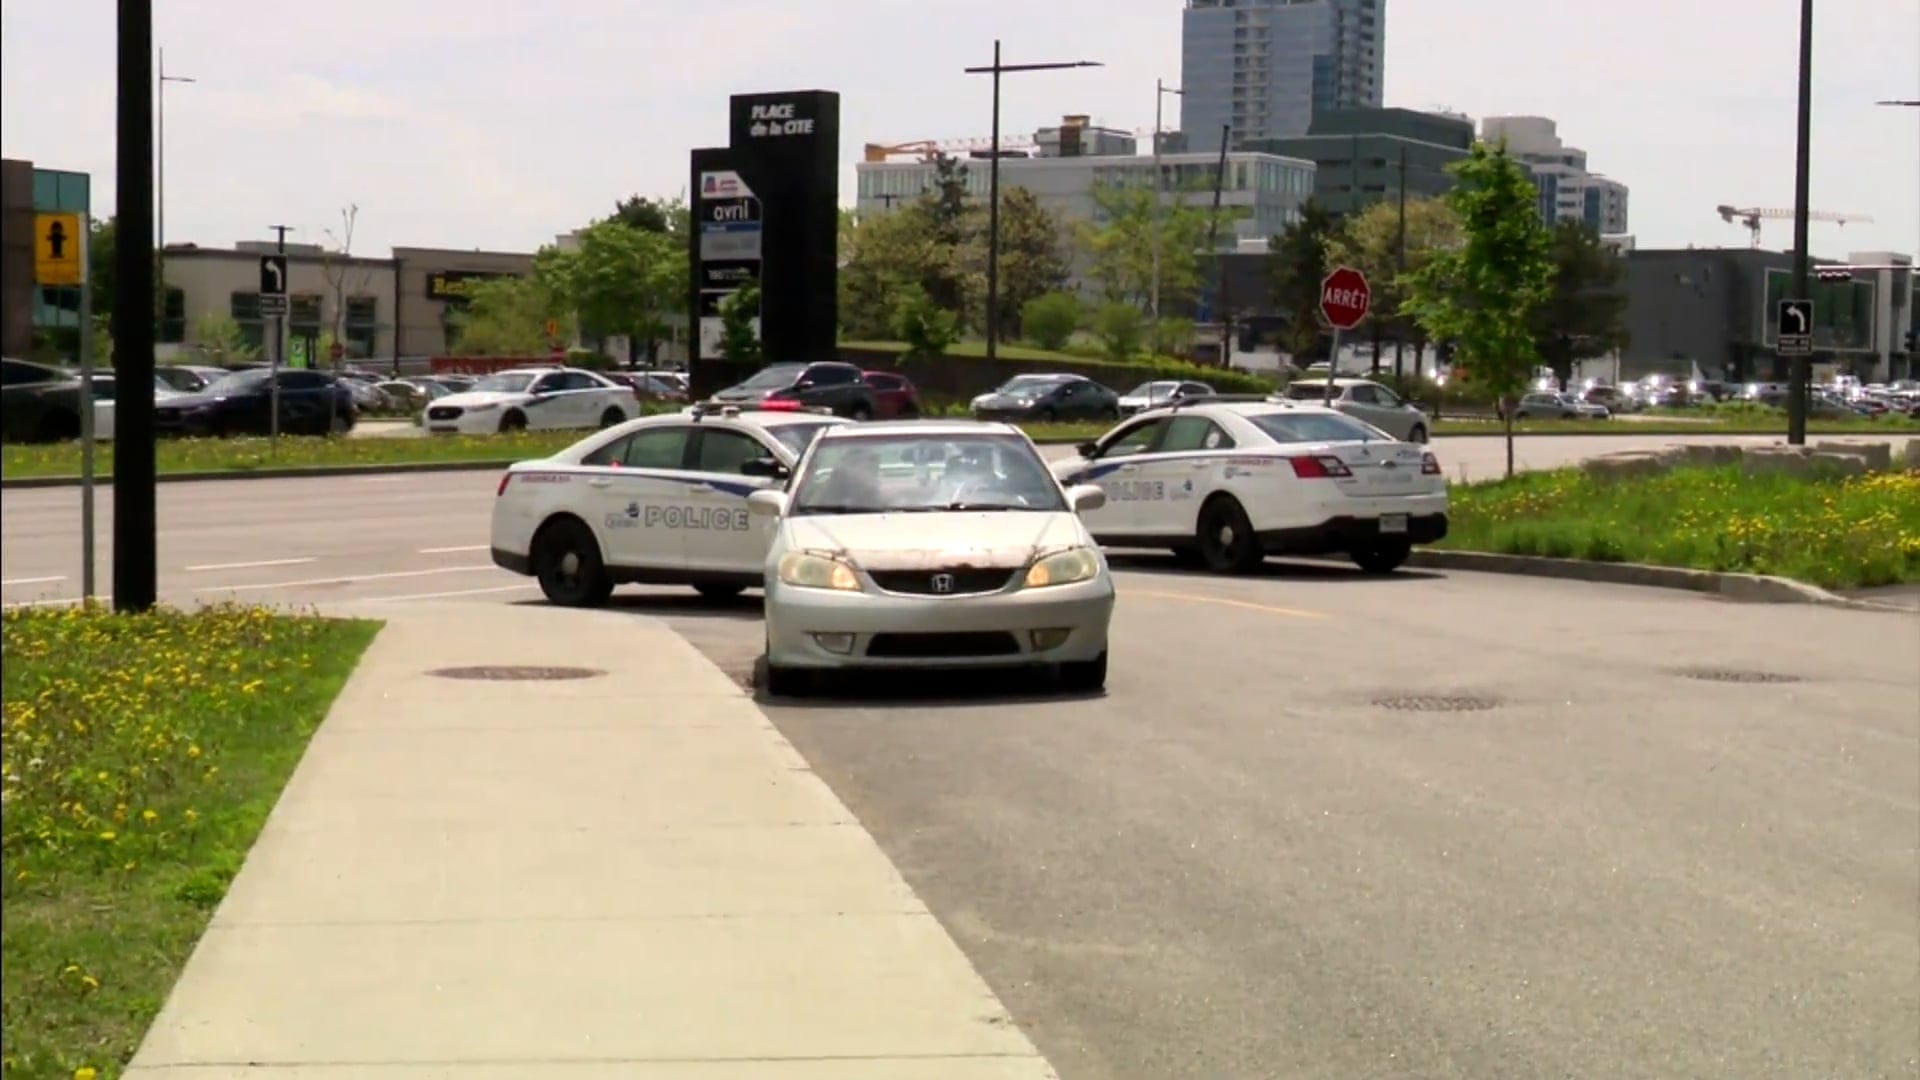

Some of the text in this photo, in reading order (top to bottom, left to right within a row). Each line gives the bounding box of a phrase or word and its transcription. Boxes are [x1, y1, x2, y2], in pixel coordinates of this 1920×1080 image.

[751, 104, 795, 119] PLACE
[750, 122, 768, 136] de
[769, 121, 783, 135] la
[714, 199, 749, 220] avril
[1324, 287, 1366, 309] ARRÊT
[644, 505, 749, 531] POLICE
